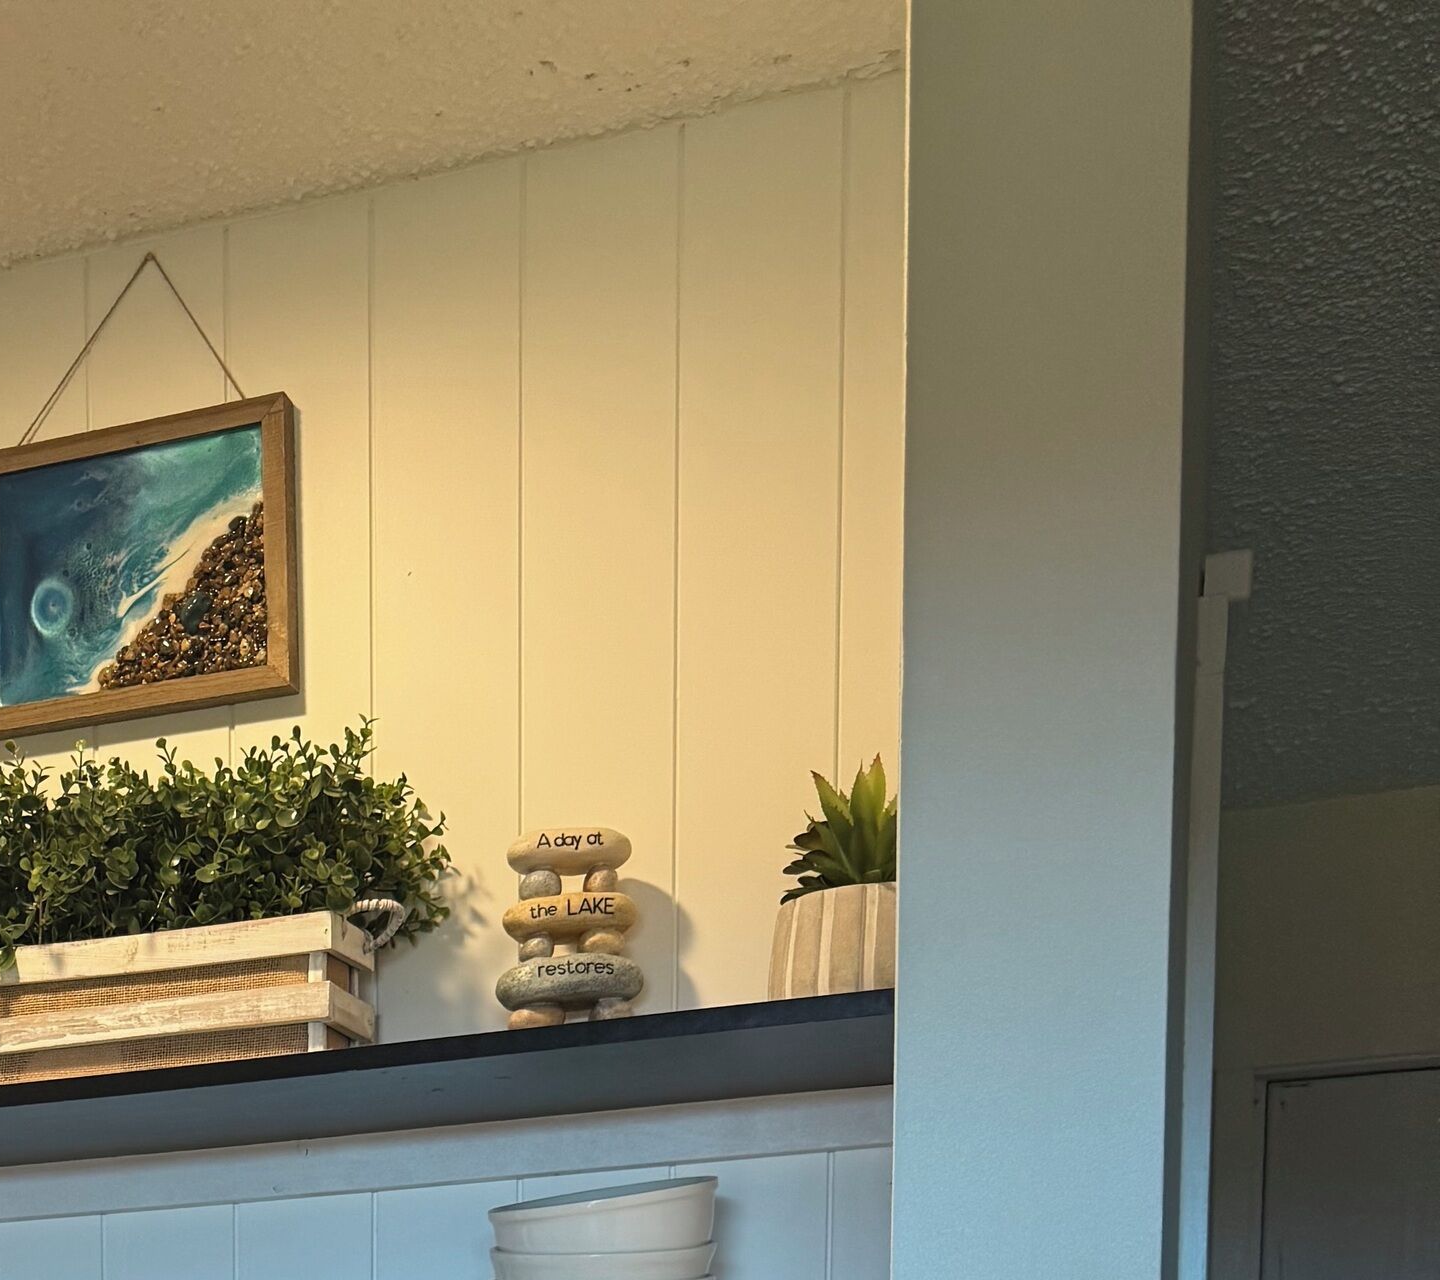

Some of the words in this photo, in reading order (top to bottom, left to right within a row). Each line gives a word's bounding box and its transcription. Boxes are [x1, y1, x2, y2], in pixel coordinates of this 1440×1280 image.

[537, 833, 551, 848] A
[554, 833, 582, 850] day
[587, 831, 603, 845] at
[530, 904, 557, 919] the
[567, 897, 615, 916] LAKE
[538, 960, 614, 977] restores
